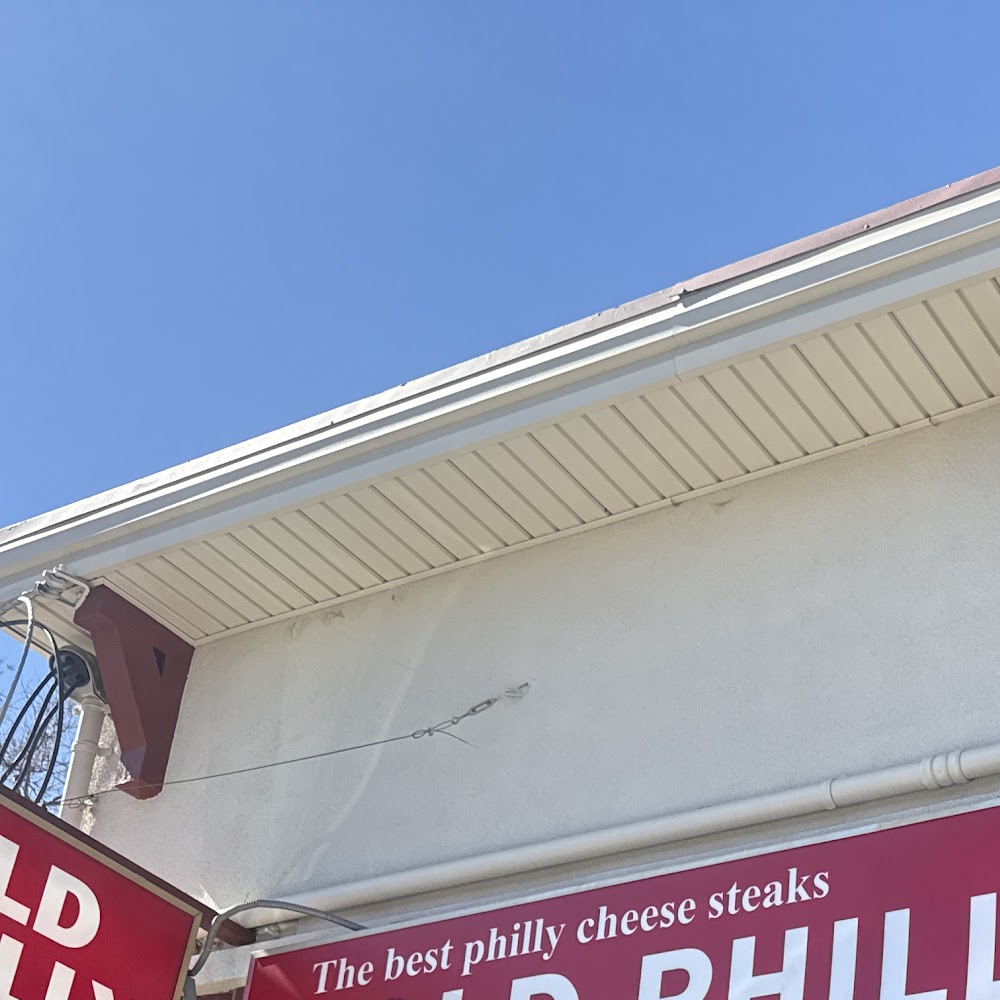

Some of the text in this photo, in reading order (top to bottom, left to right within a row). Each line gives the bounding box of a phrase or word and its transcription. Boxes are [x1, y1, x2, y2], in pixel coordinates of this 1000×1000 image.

[313, 867, 831, 995] The best philly cheese steaks
